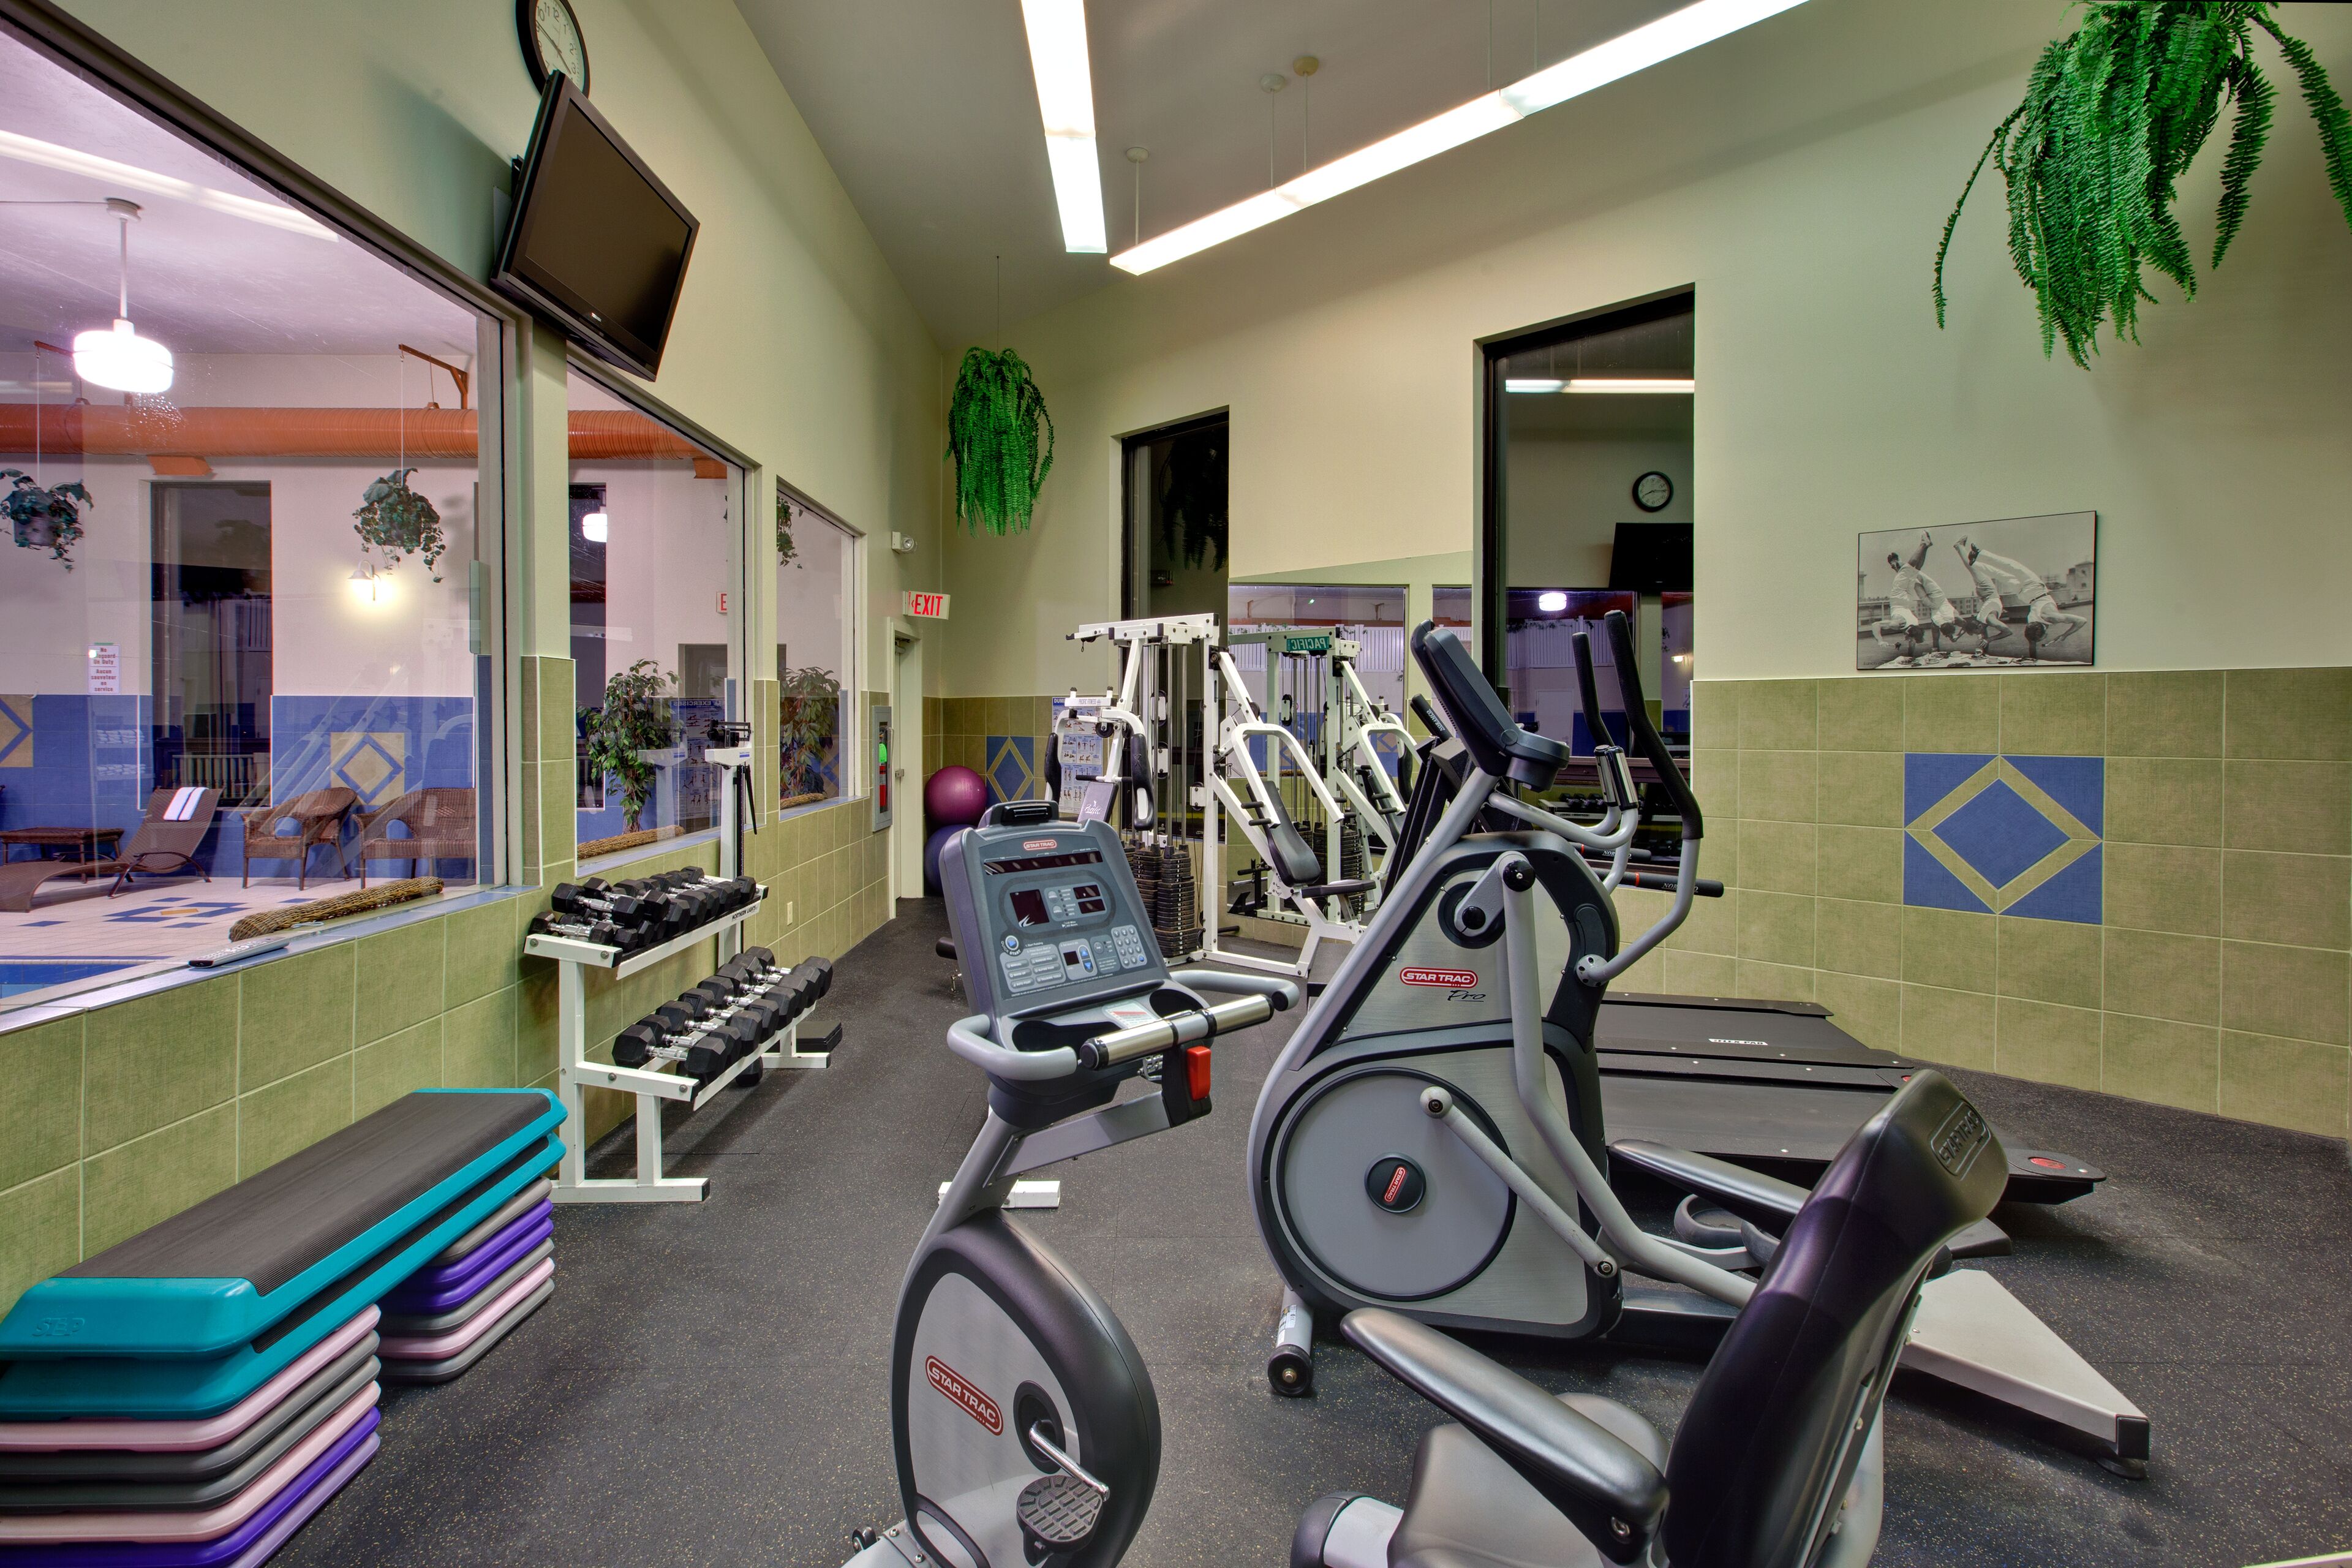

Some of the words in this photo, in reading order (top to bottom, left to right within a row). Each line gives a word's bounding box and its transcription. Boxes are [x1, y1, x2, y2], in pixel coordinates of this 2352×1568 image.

[914, 594, 944, 617] EXIT
[1406, 972, 1436, 981] STAR
[1438, 974, 1471, 983] TRAC
[1447, 990, 1486, 1001] Pro
[1393, 1168, 1403, 1185] STAR
[1387, 1185, 1397, 1200] TRAC
[929, 1366, 961, 1396] STAR
[963, 1389, 996, 1423] TRAC
